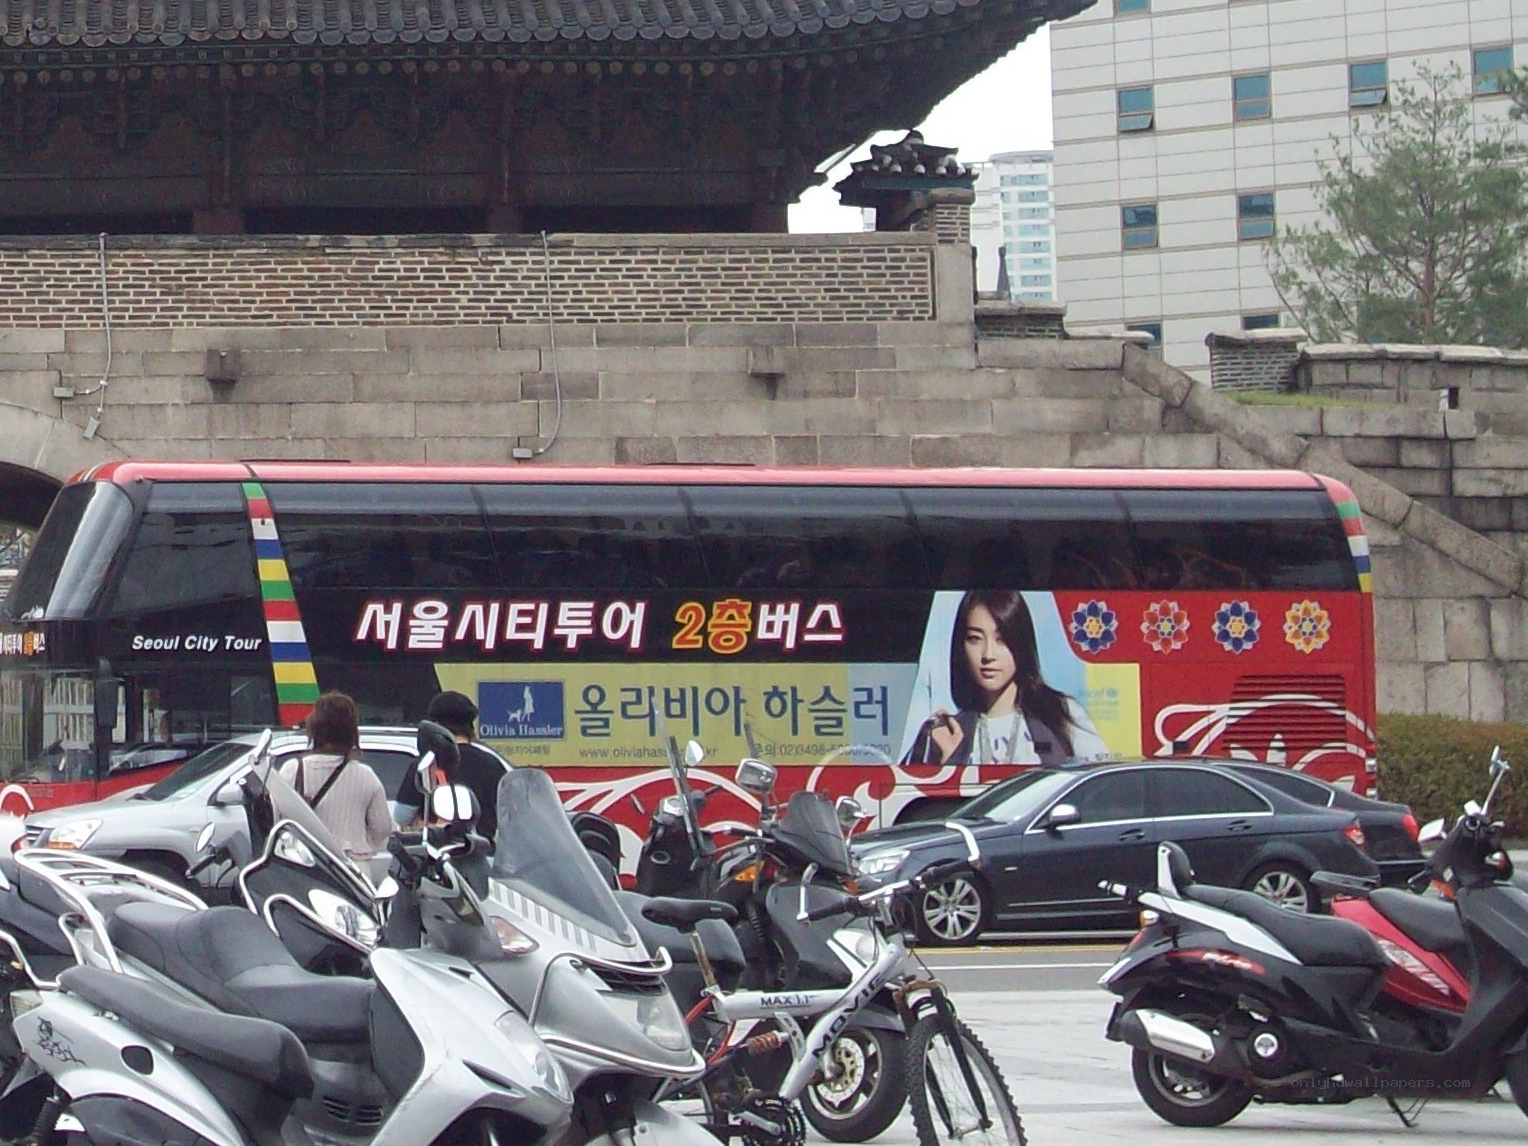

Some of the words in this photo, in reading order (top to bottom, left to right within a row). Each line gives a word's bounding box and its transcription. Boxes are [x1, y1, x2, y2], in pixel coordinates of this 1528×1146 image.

[131, 635, 179, 651] Seoul
[184, 635, 219, 653] City
[224, 635, 262, 651] Tour
[356, 599, 646, 650] 서울시티투어
[671, 599, 844, 654] 2층버스
[574, 685, 747, 738] 올리비아
[763, 685, 892, 738] 하슬러
[480, 724, 517, 737] Olivia
[518, 724, 564, 737] Hassler
[760, 994, 793, 1007] MAX
[811, 972, 885, 1058] MOVIE
